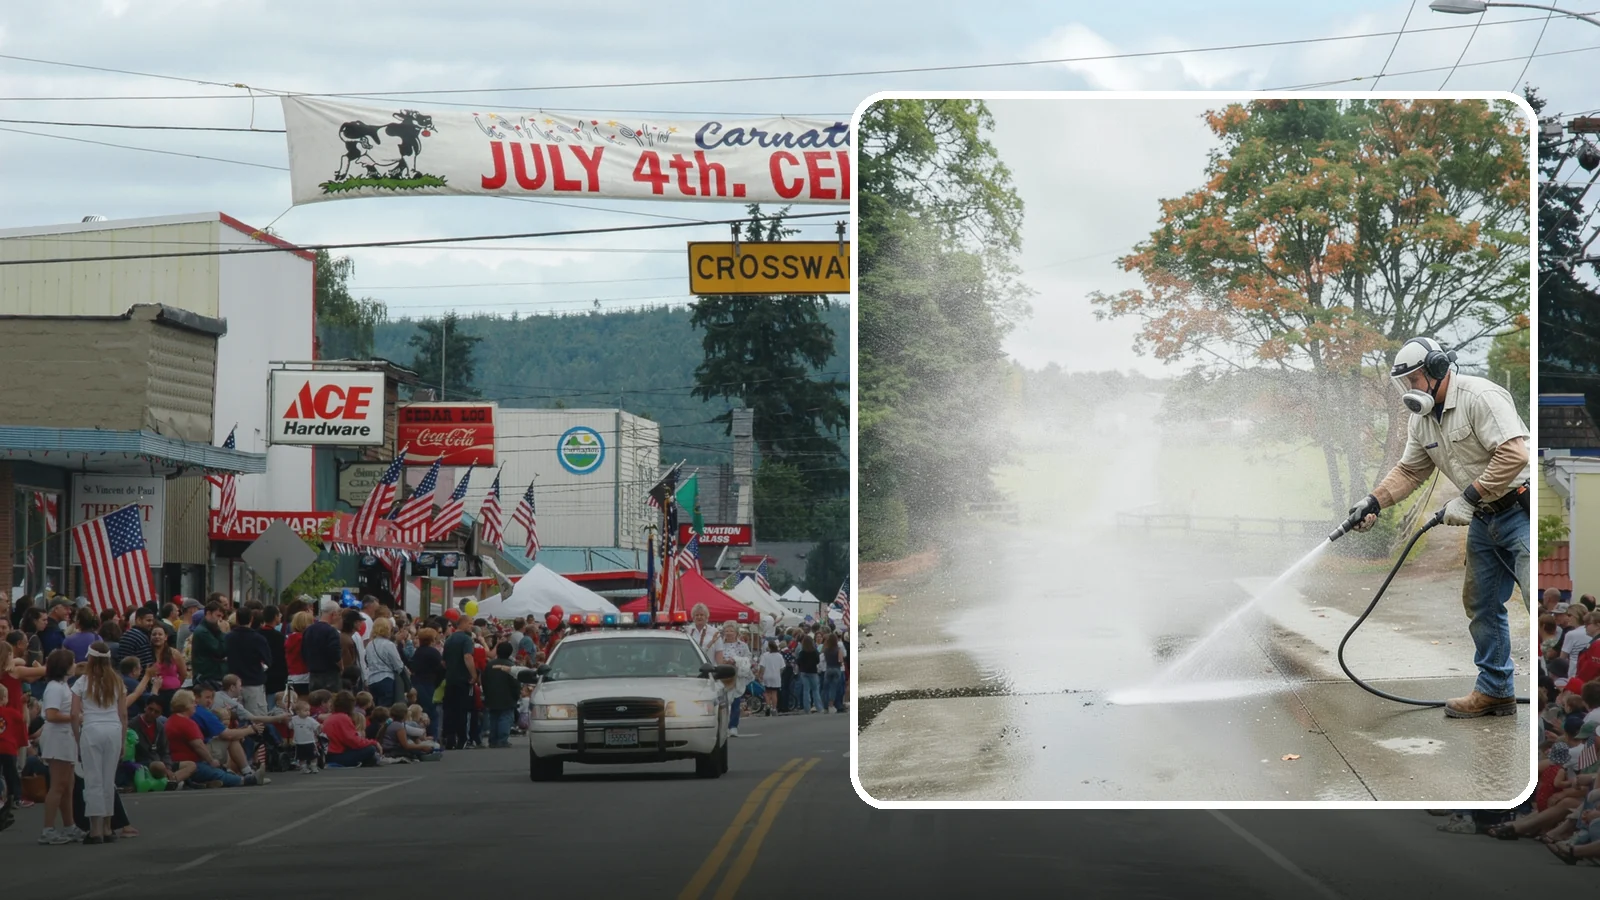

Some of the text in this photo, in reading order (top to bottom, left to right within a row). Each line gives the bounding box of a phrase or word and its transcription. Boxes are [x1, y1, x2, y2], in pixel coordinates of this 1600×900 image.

[481, 141, 605, 192] JULY
[632, 150, 746, 197] 4th.
[697, 254, 850, 280] CROSSWA
[283, 380, 373, 420] ACE
[406, 409, 453, 422] CEDAR
[283, 421, 371, 436] Hardware
[416, 428, 476, 447] Coca-Cola
[353, 467, 386, 480] Simpl
[96, 485, 124, 494] Vincent
[126, 486, 136, 494] de
[138, 486, 155, 495] Paul
[81, 503, 154, 522] THT
[213, 516, 330, 535] HARDARE
[688, 526, 741, 535] CRNATION
[699, 535, 730, 543] GLASS
